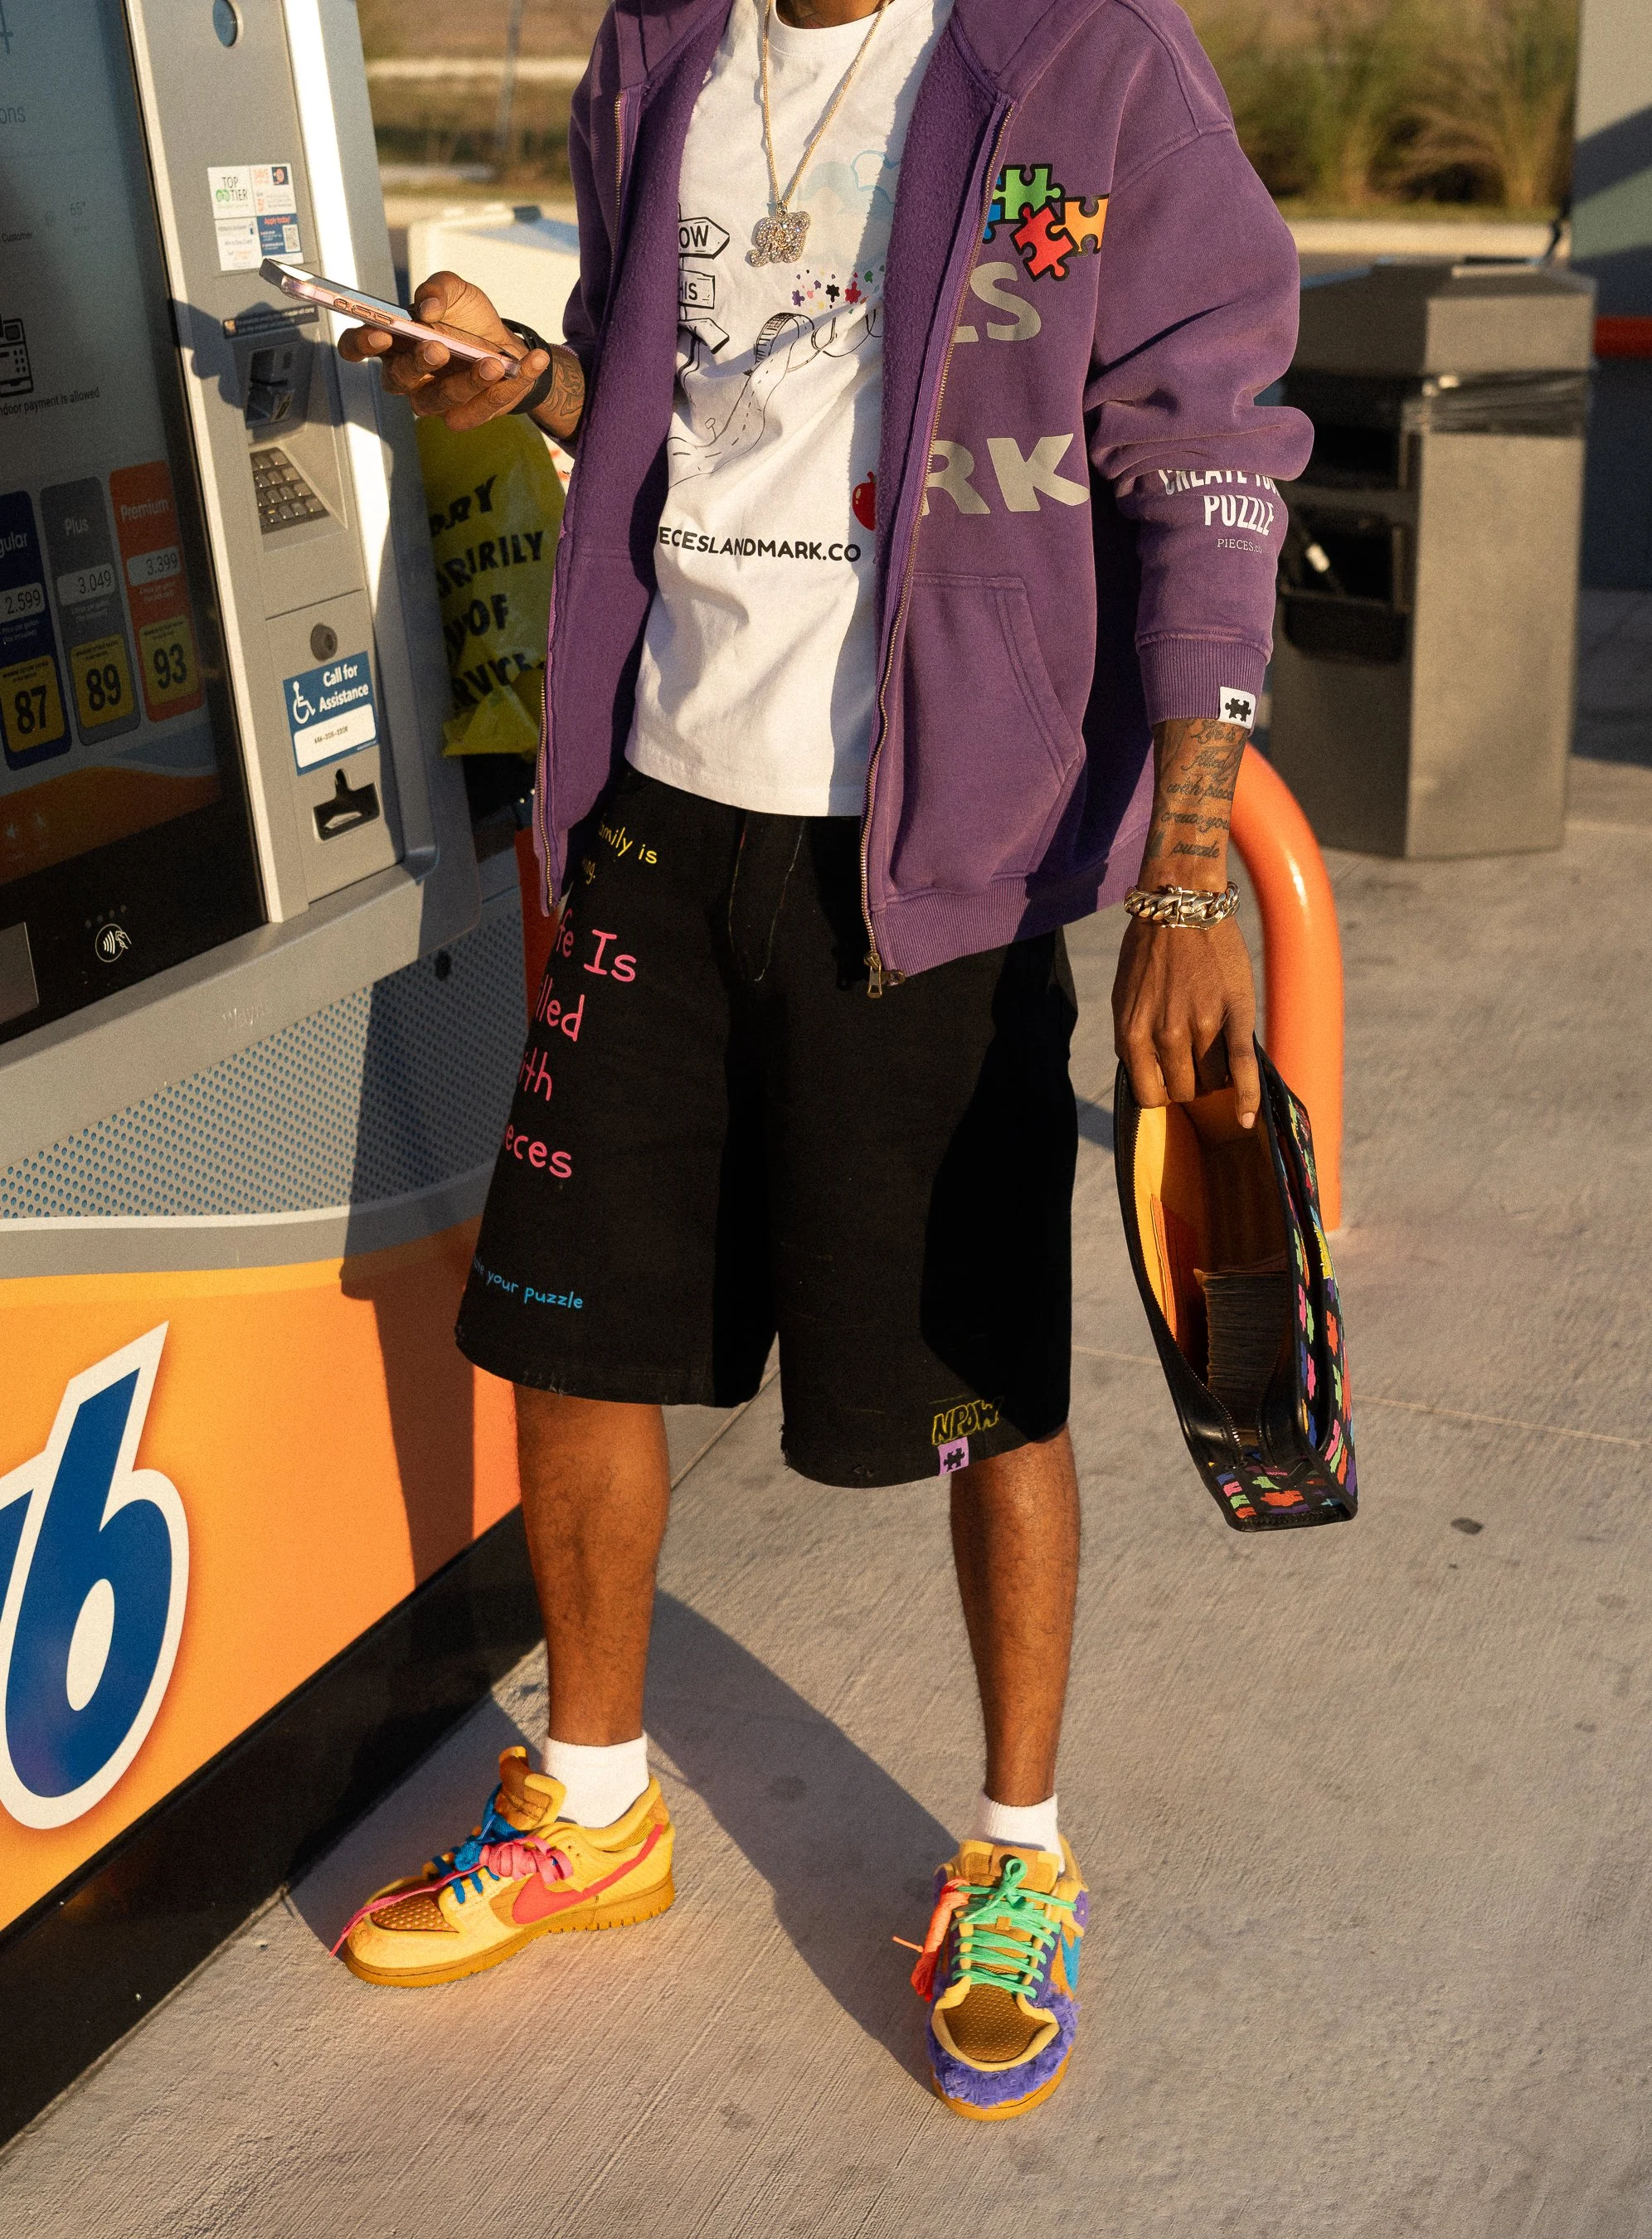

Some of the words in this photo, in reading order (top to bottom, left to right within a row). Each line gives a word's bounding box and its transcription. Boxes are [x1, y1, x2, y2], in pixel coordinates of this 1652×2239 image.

[221, 177, 239, 189] TOP
[231, 189, 248, 202] TIER
[2, 232, 33, 242] Customer
[678, 225, 709, 249] OW
[24, 395, 59, 414] payment
[61, 393, 68, 405] is
[70, 386, 100, 403] allowed
[921, 433, 1091, 517] RK
[120, 499, 169, 521] Premium
[1203, 494, 1275, 537] PUZZLE
[65, 517, 89, 536] Plus
[0, 531, 27, 558] gular
[658, 527, 862, 562] ECESLANDMARK.CO
[146, 552, 177, 576] 3.399
[78, 570, 111, 595] 3.049
[5, 589, 41, 614] 2.599
[469, 594, 508, 636] OF
[153, 644, 187, 690] 93
[323, 666, 343, 687] Call
[343, 663, 357, 681] for
[86, 663, 121, 711] 89
[319, 683, 369, 712] Assistance
[14, 685, 47, 735] 87
[638, 843, 658, 864] is
[583, 929, 637, 982] Is
[486, 1270, 519, 1294] your
[523, 1286, 584, 1309] puzzle
[0, 1320, 190, 1829] 6
